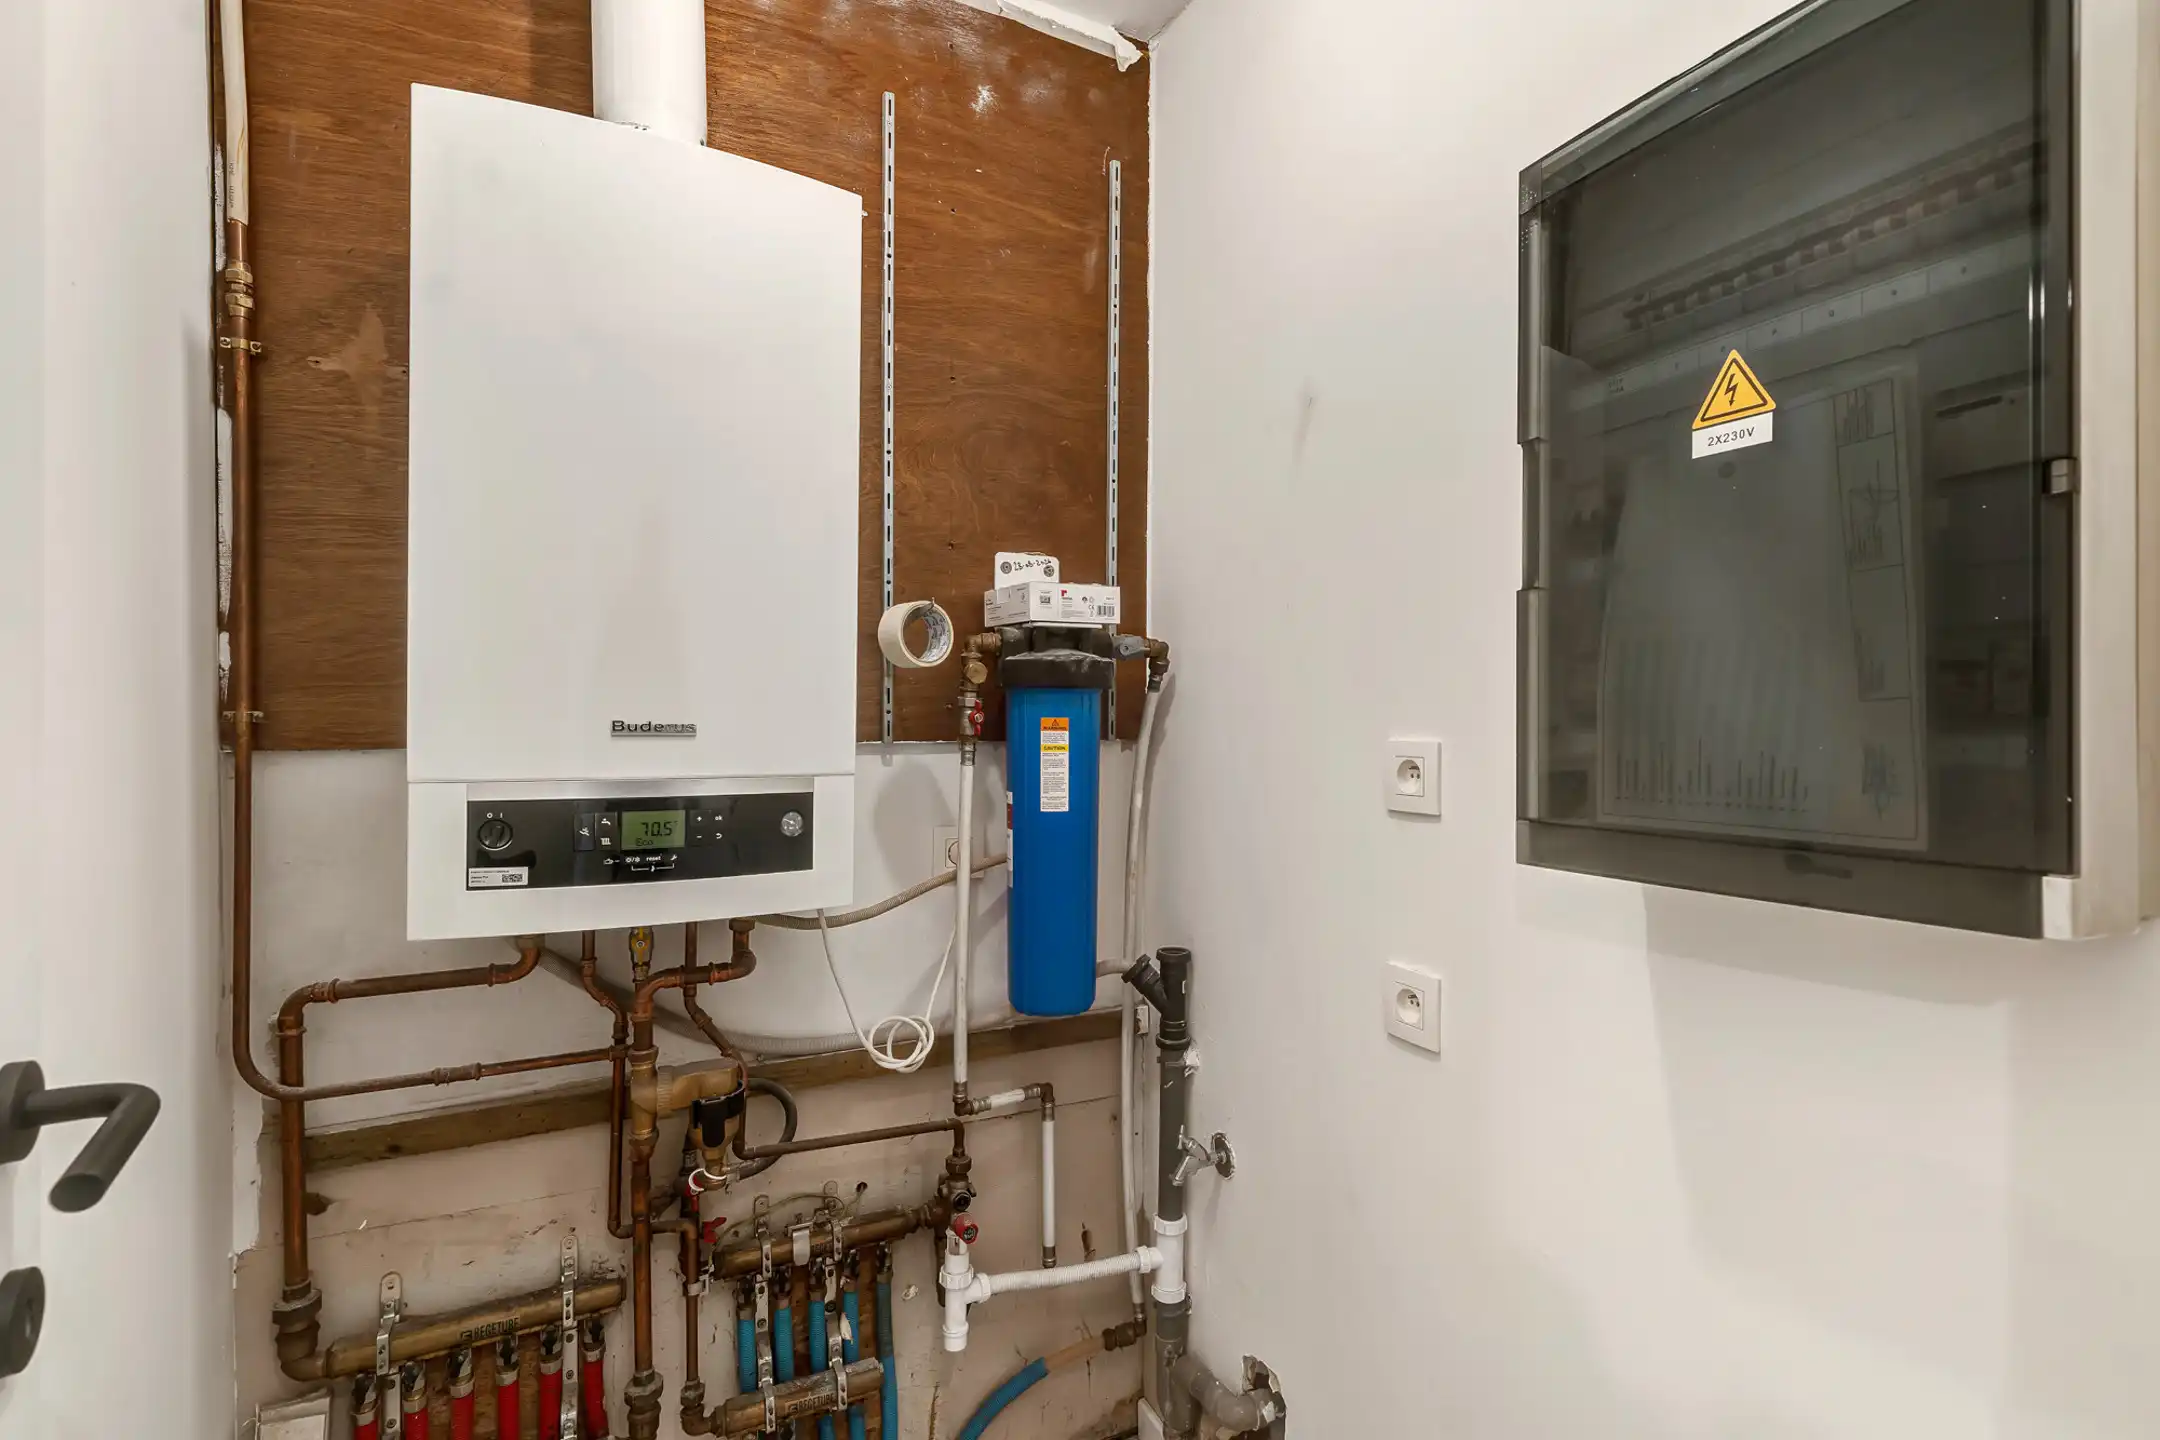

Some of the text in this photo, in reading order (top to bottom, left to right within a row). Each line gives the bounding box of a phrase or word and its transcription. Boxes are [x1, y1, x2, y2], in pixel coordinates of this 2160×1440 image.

[1707, 427, 1755, 447] 2X230V
[612, 720, 696, 733] Buderus
[636, 837, 654, 847] Eco
[474, 1317, 519, 1339] BEGETUBE
